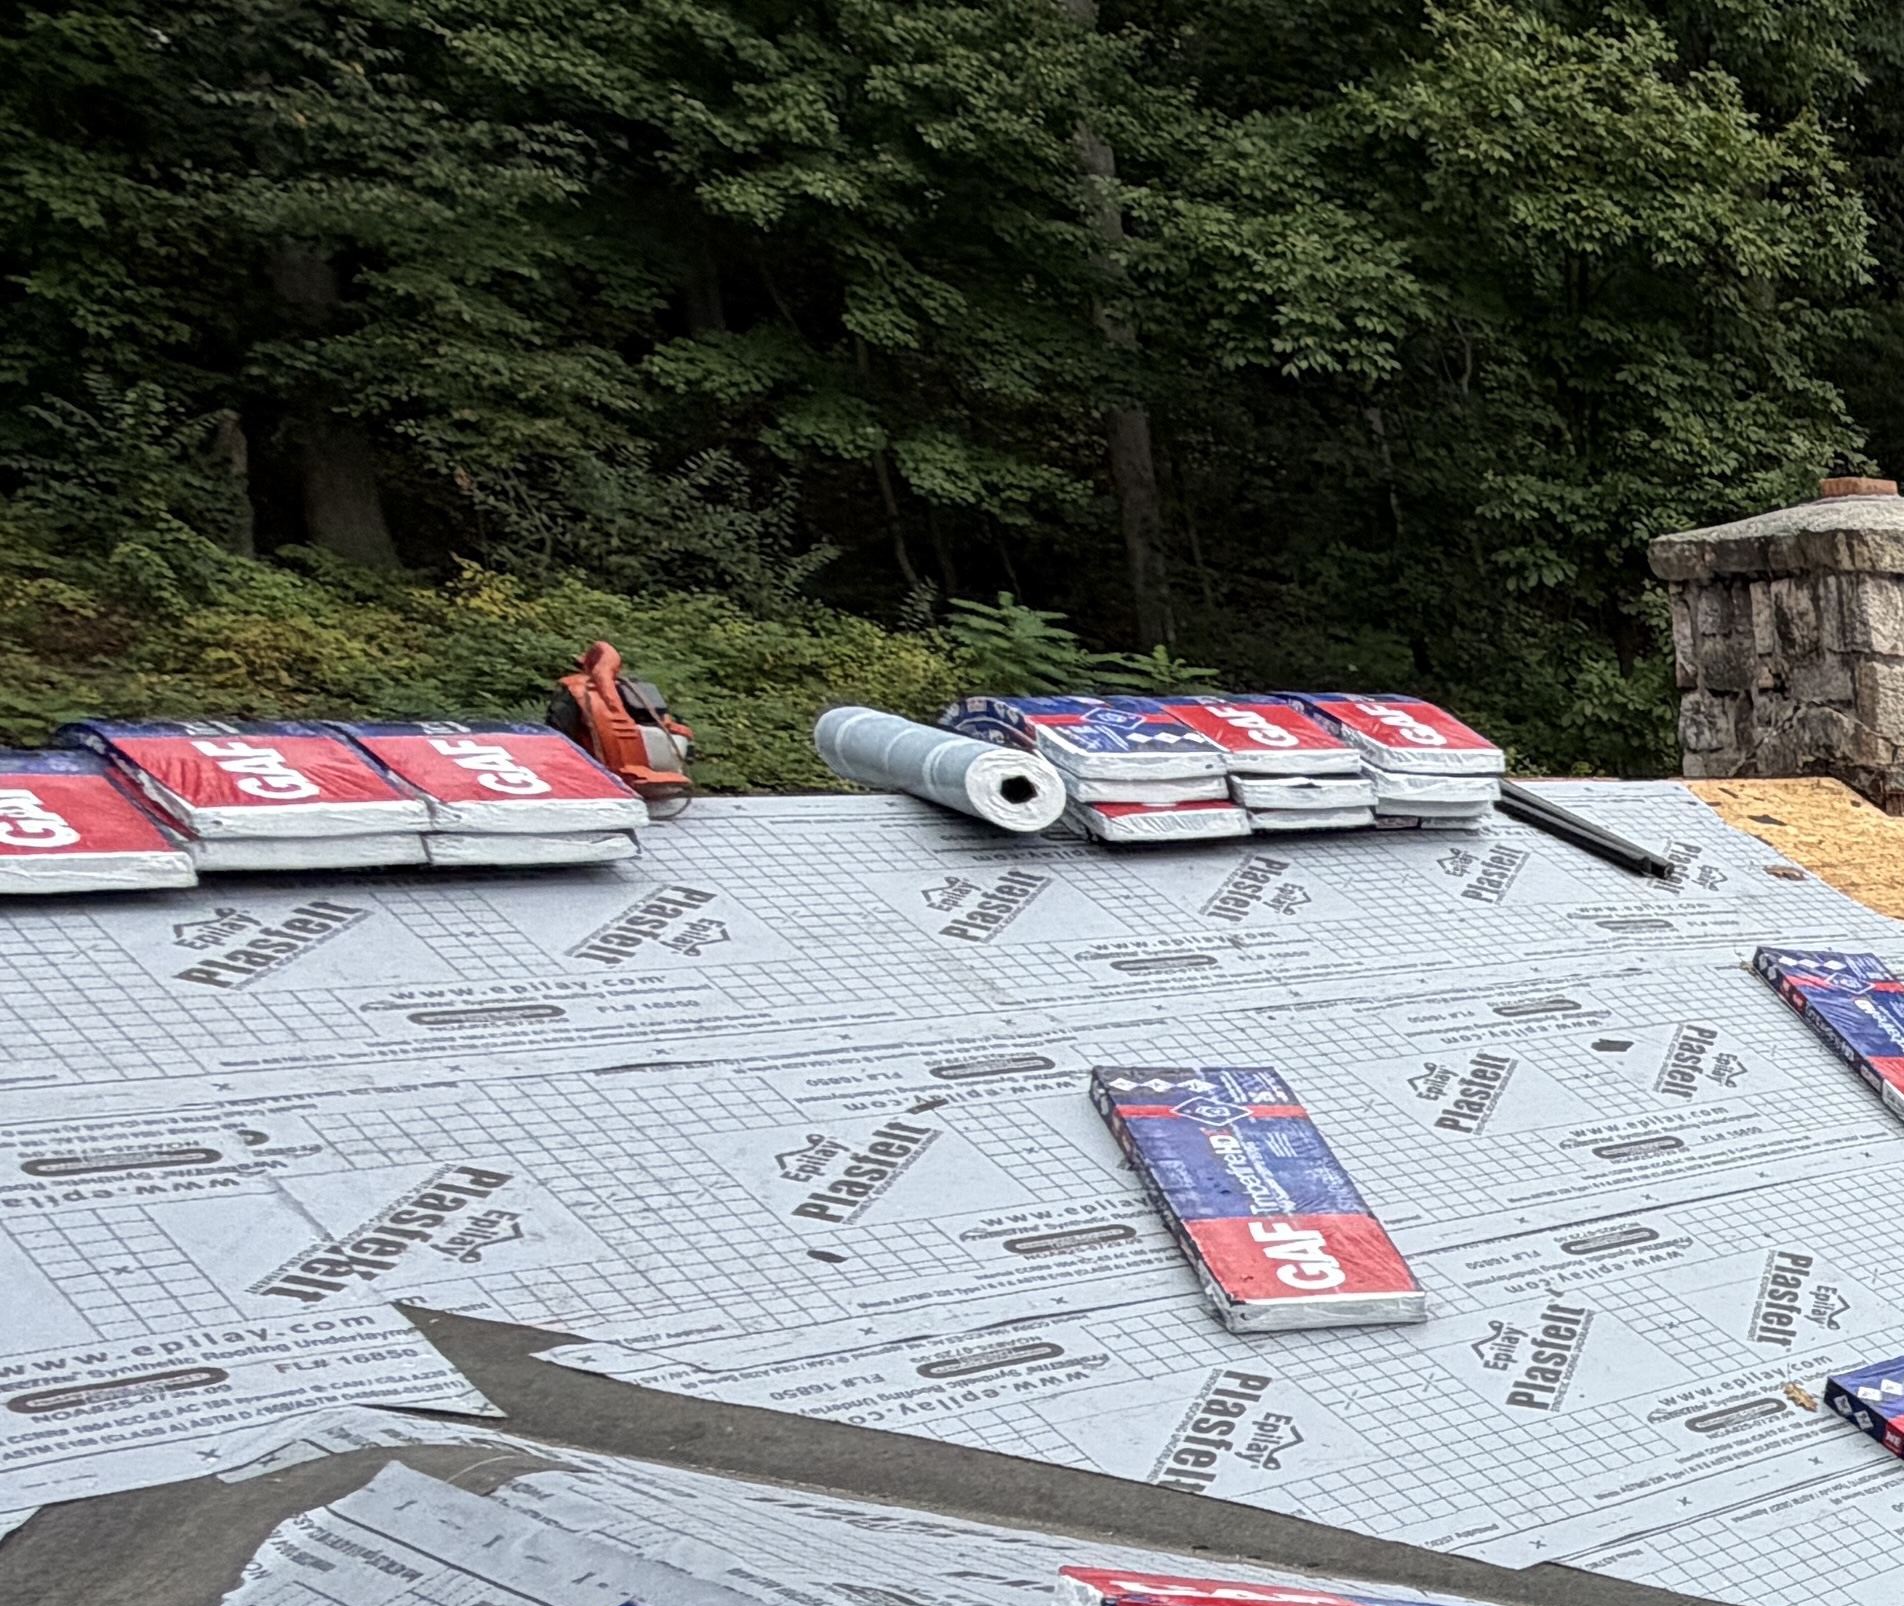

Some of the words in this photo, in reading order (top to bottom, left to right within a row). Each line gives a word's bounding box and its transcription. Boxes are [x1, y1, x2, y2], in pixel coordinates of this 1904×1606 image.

[1209, 706, 1299, 747] GAF
[1358, 703, 1447, 744] GAF
[197, 741, 320, 800] GAF
[431, 738, 553, 796] GAF
[939, 870, 1049, 942] Plasfelt
[1228, 858, 1289, 923] Plasfelt
[174, 901, 362, 989] Plasfelt
[572, 886, 716, 968] Plasfelt
[1434, 1053, 1512, 1133] Plasfelt
[1661, 1025, 1718, 1098] Plasfelt
[781, 1139, 844, 1181] Epilay
[792, 1122, 932, 1223] Plasfelt
[1253, 1222, 1347, 1289] GAF
[1756, 1251, 1812, 1345] Plasfelt
[1507, 1301, 1580, 1412] Plasfelt
[1159, 1370, 1272, 1492] Plasfelt
[1242, 1412, 1292, 1470] Epilay
